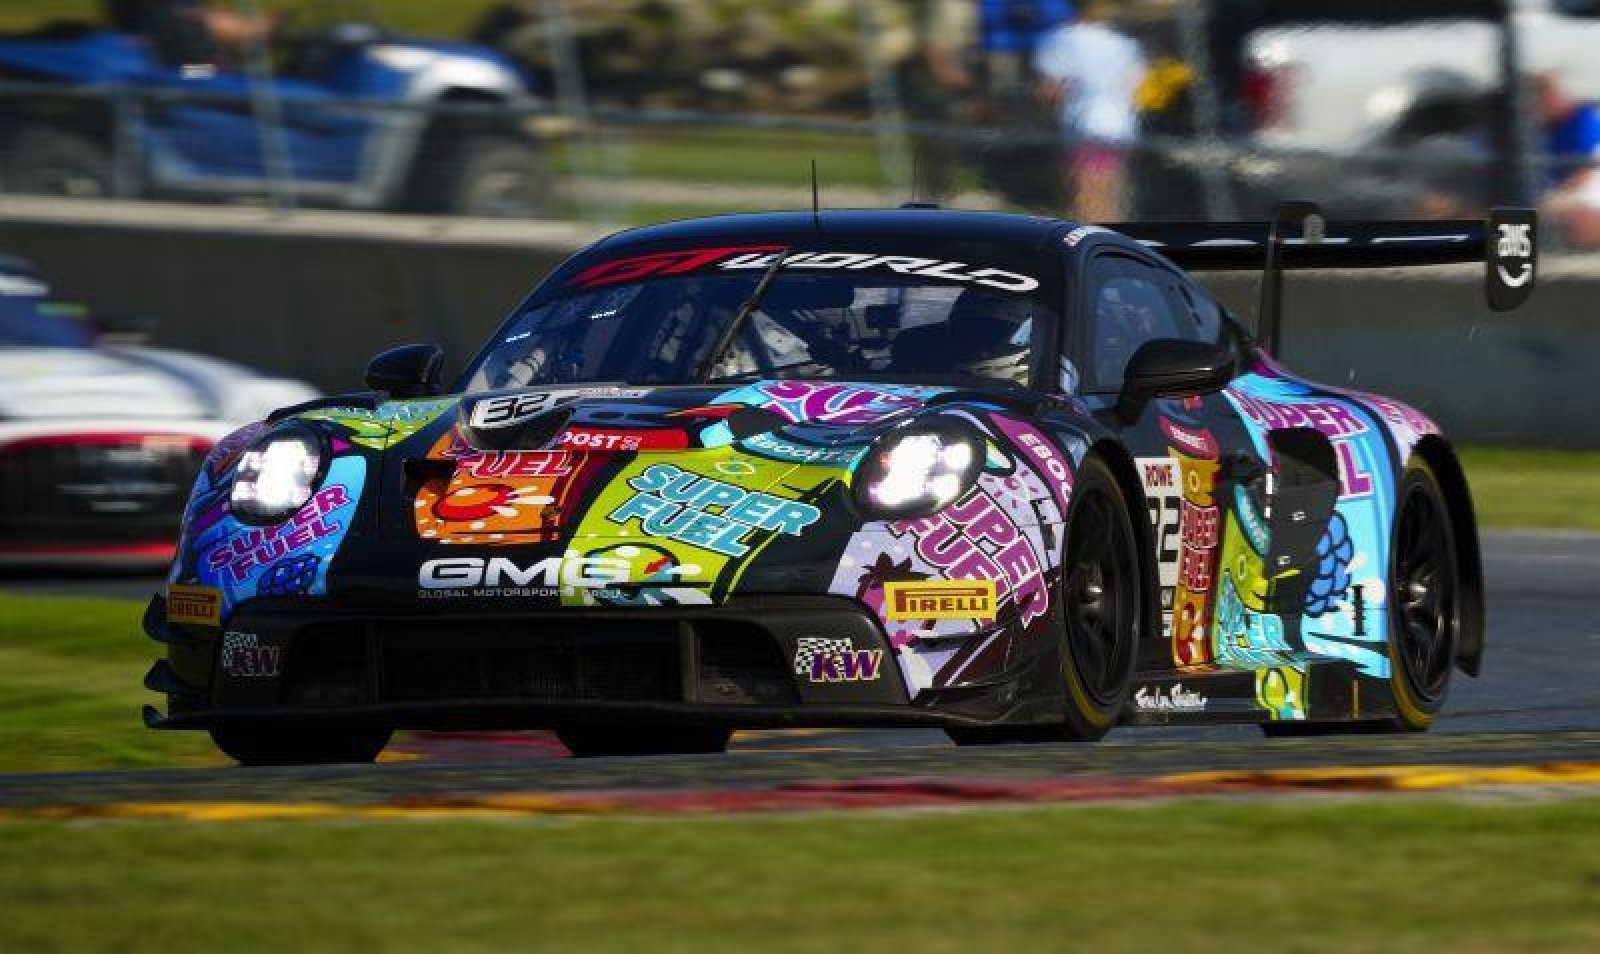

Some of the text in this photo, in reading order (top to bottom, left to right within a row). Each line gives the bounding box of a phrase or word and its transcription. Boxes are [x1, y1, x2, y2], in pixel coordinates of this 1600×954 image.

[717, 252, 1040, 292] WORLD
[482, 393, 550, 424] 32
[626, 464, 822, 537] SUPER
[206, 484, 351, 573] SUPER
[607, 491, 752, 558] FUEL
[228, 519, 341, 582] FUEL
[944, 484, 1050, 631] UPER
[417, 557, 630, 589] GMG
[418, 588, 470, 599] GLOBAL
[474, 588, 574, 599] MOTORSPOR
[893, 587, 989, 613] PIRELLI
[809, 649, 884, 683] KW
